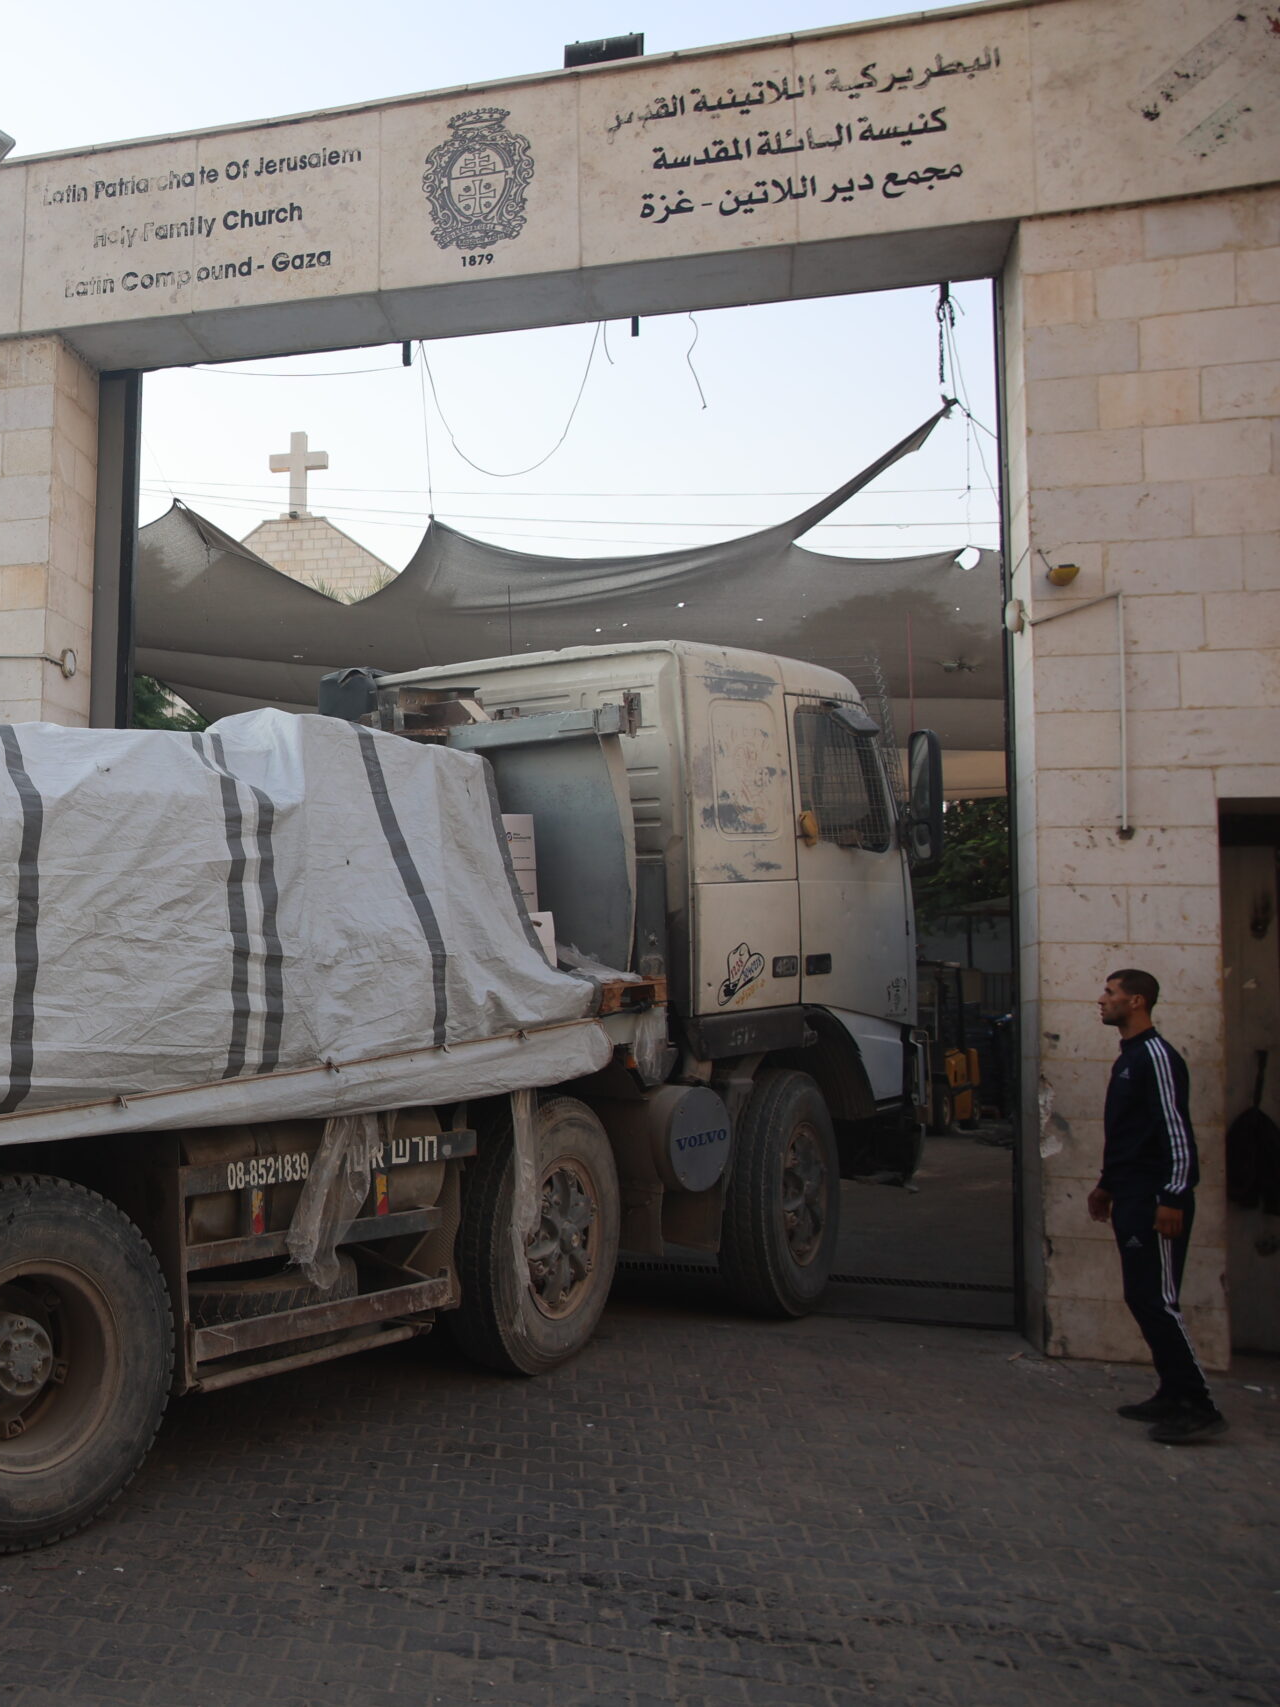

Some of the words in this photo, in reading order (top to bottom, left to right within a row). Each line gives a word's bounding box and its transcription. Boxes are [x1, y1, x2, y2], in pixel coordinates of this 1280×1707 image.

[690, 74, 816, 120] اللاتينية
[757, 122, 852, 155] الائلة
[858, 106, 948, 147] كنيسة
[225, 158, 250, 181] Of
[254, 147, 362, 177] Jerusalem
[652, 137, 752, 171] المقدسة
[718, 174, 817, 217] اللاتين
[821, 173, 874, 203] دير
[882, 161, 963, 198] مجمع
[143, 215, 216, 242] Family
[222, 202, 303, 231] Church
[638, 187, 695, 224] غزة
[271, 250, 332, 273] Gaza
[461, 253, 494, 268] 1879
[675, 1128, 727, 1151] VOLVO
[226, 1151, 310, 1191] 08-8521839
